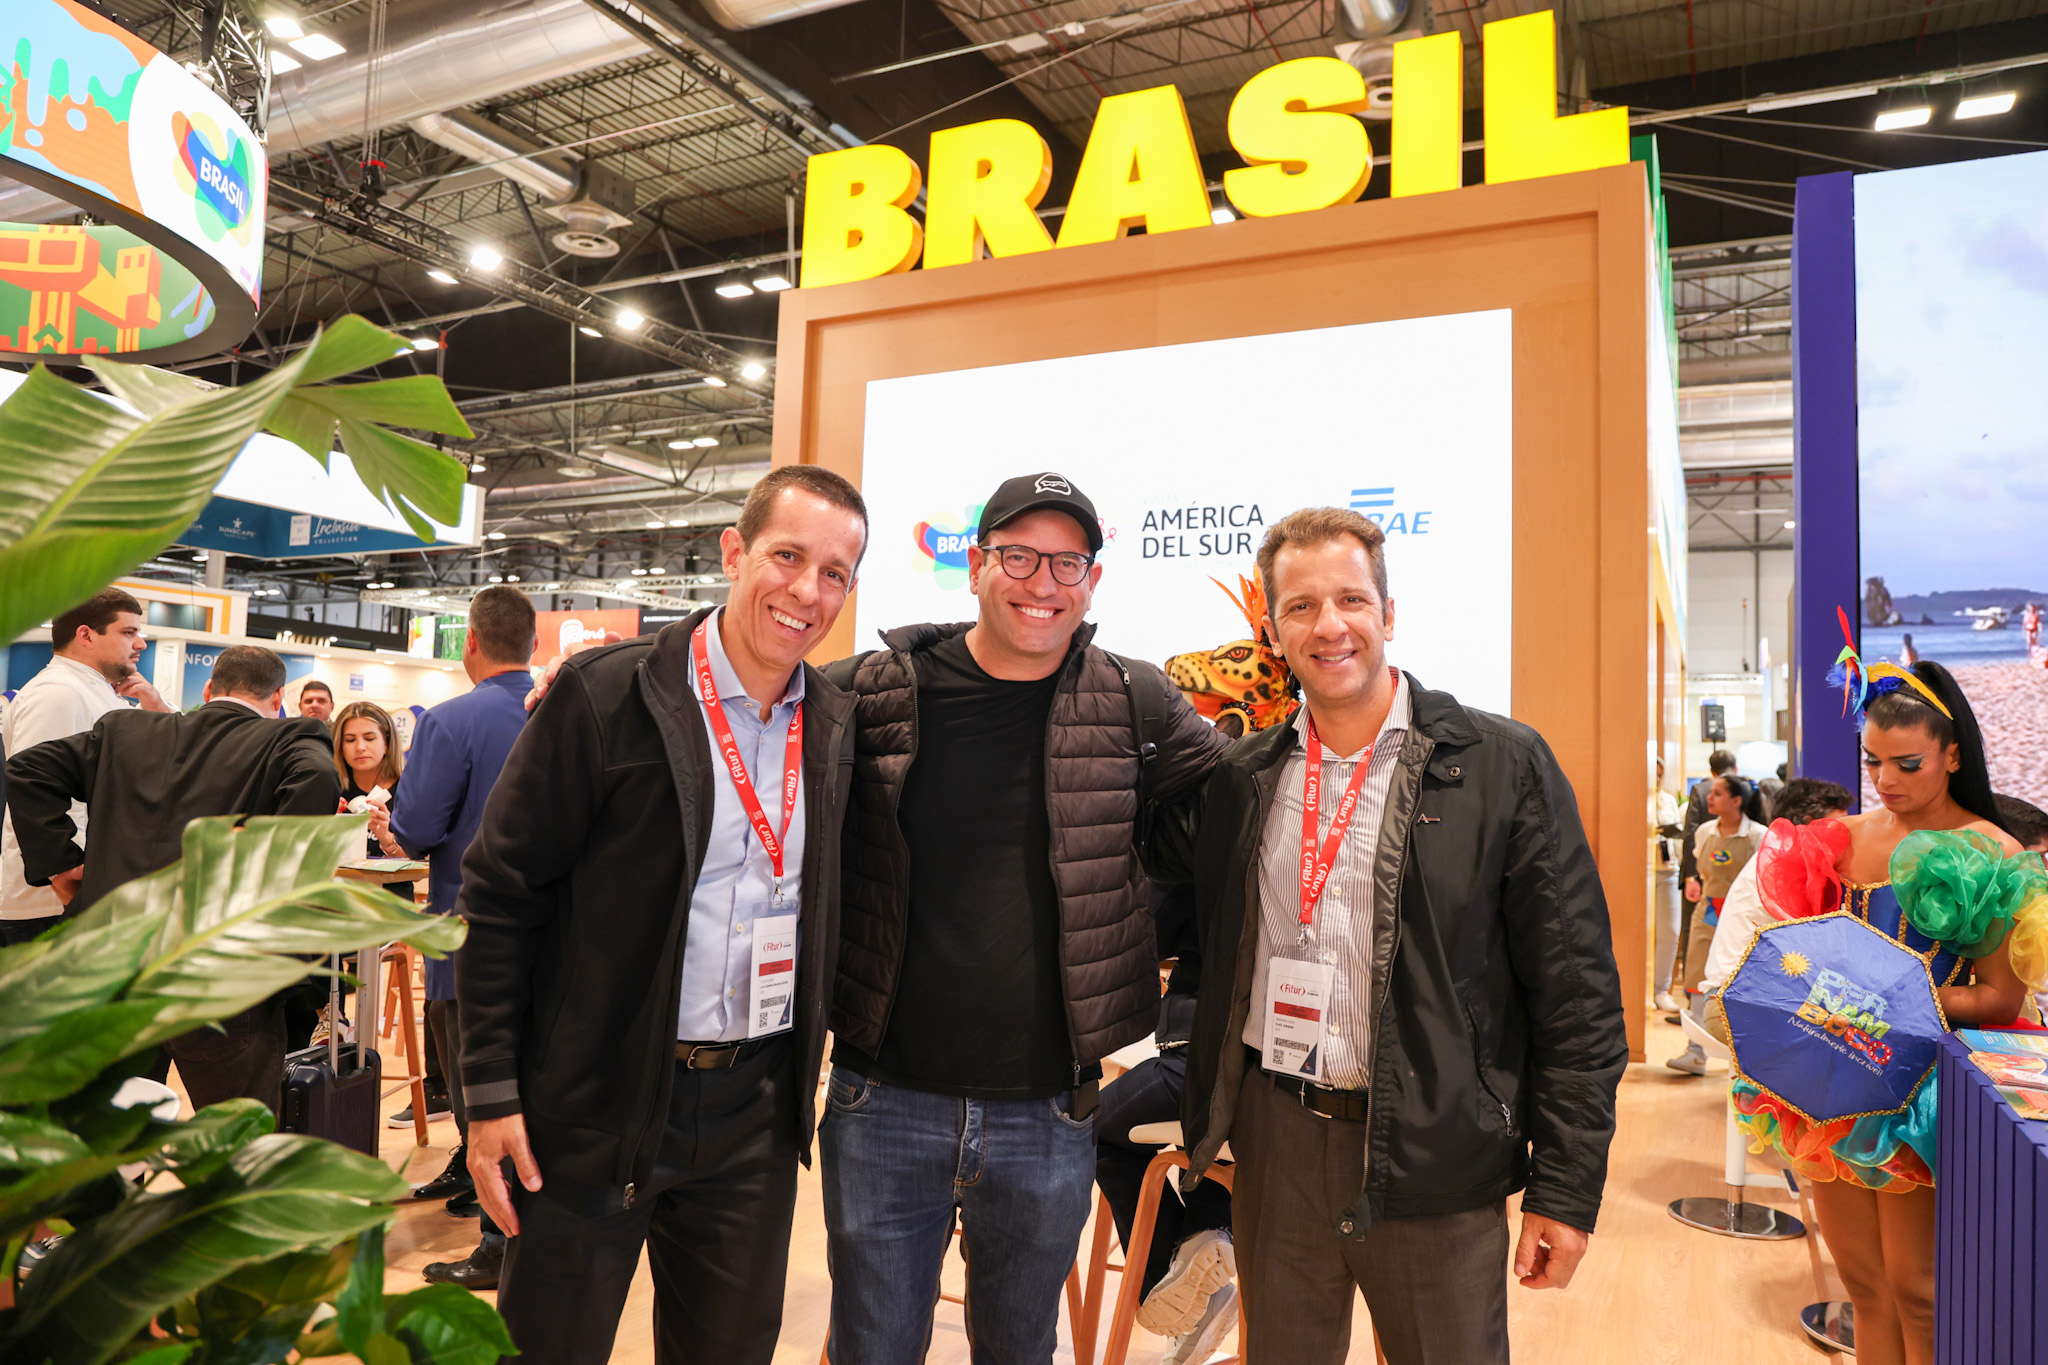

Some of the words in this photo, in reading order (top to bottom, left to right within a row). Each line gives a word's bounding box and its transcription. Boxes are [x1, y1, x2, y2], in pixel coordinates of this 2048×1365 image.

[800, 10, 1630, 288] BRASIL
[200, 157, 243, 215] BRASIL
[1141, 500, 1265, 532] AMÉRICA
[1142, 535, 1191, 559] DEL
[1198, 532, 1253, 557] SUR
[396, 717, 406, 728] 21
[1807, 984, 1891, 1040] NAM
